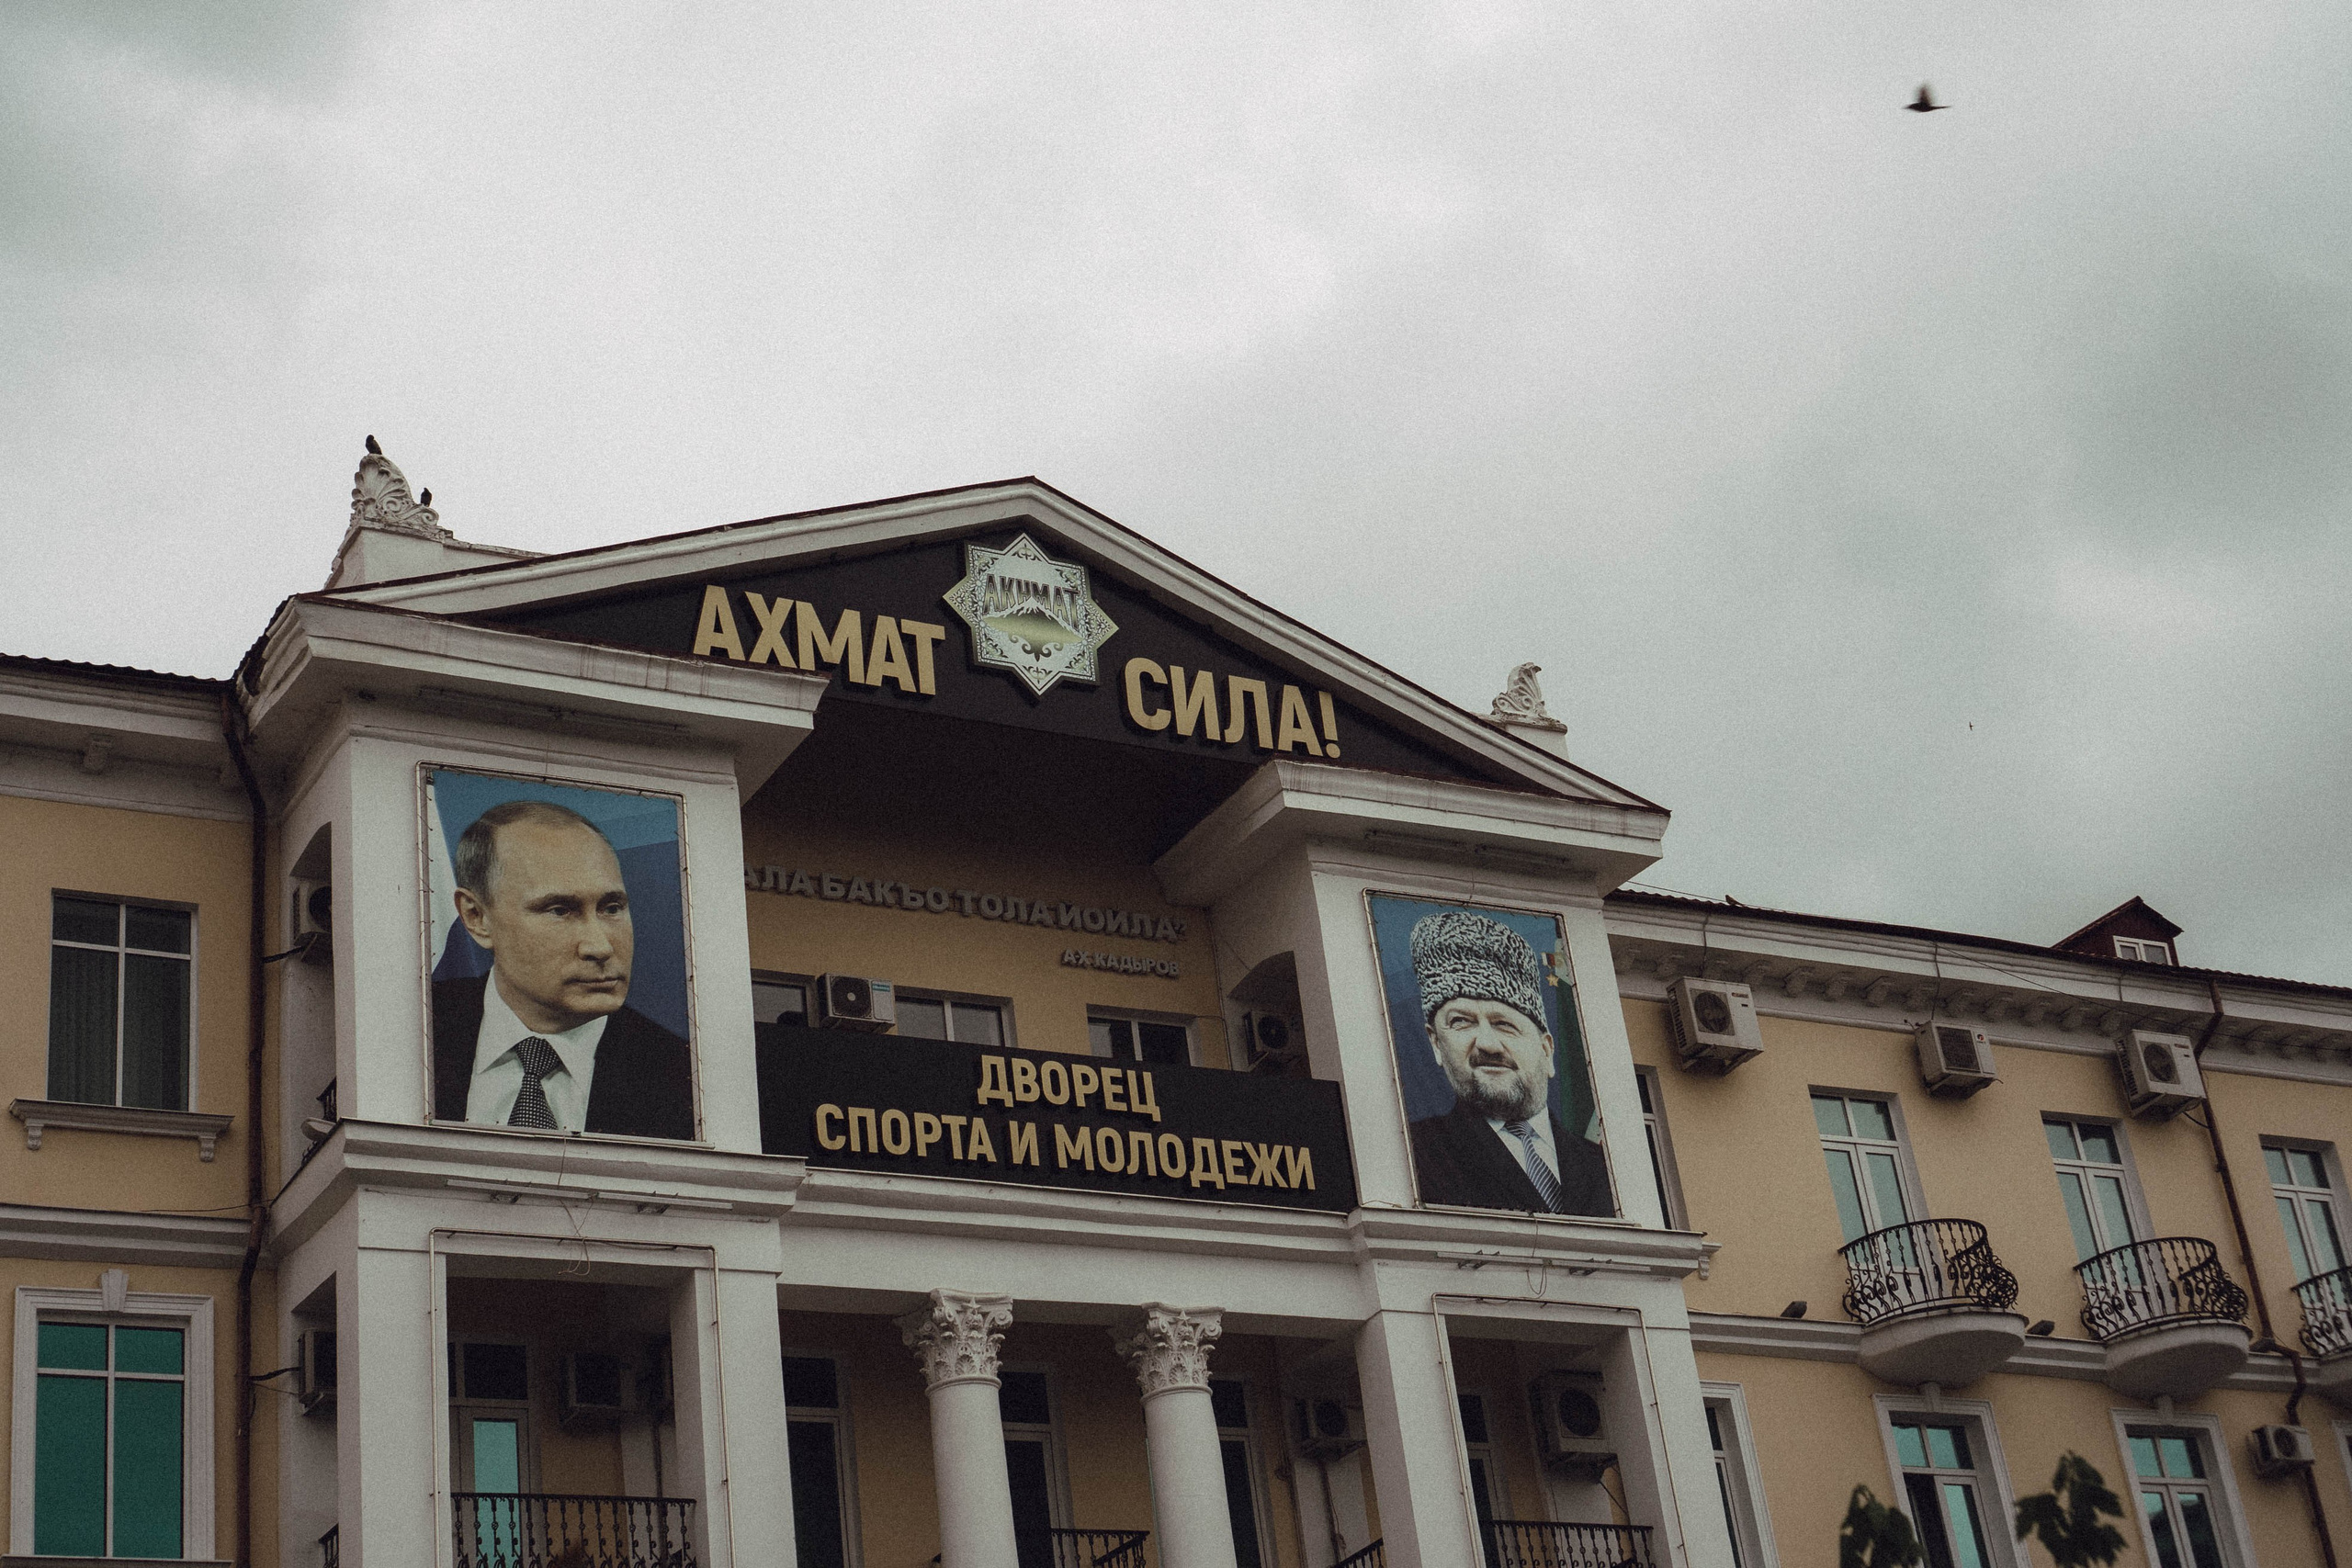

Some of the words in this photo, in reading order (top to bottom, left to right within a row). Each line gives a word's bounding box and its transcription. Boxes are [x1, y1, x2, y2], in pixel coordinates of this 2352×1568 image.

[982, 573, 1080, 630] AKHMAT
[693, 585, 945, 695] АХМАТ
[1125, 657, 1340, 758] СИЛА!
[823, 874, 949, 911] БАКЪО
[1093, 953, 1180, 976] КАДЫРОВ
[978, 1055, 1161, 1122] ДВОРЕЦ
[816, 1103, 996, 1162] СПОРТА
[1010, 1121, 1040, 1167] И
[1054, 1123, 1316, 1190] МОЛОДЕЖИ
